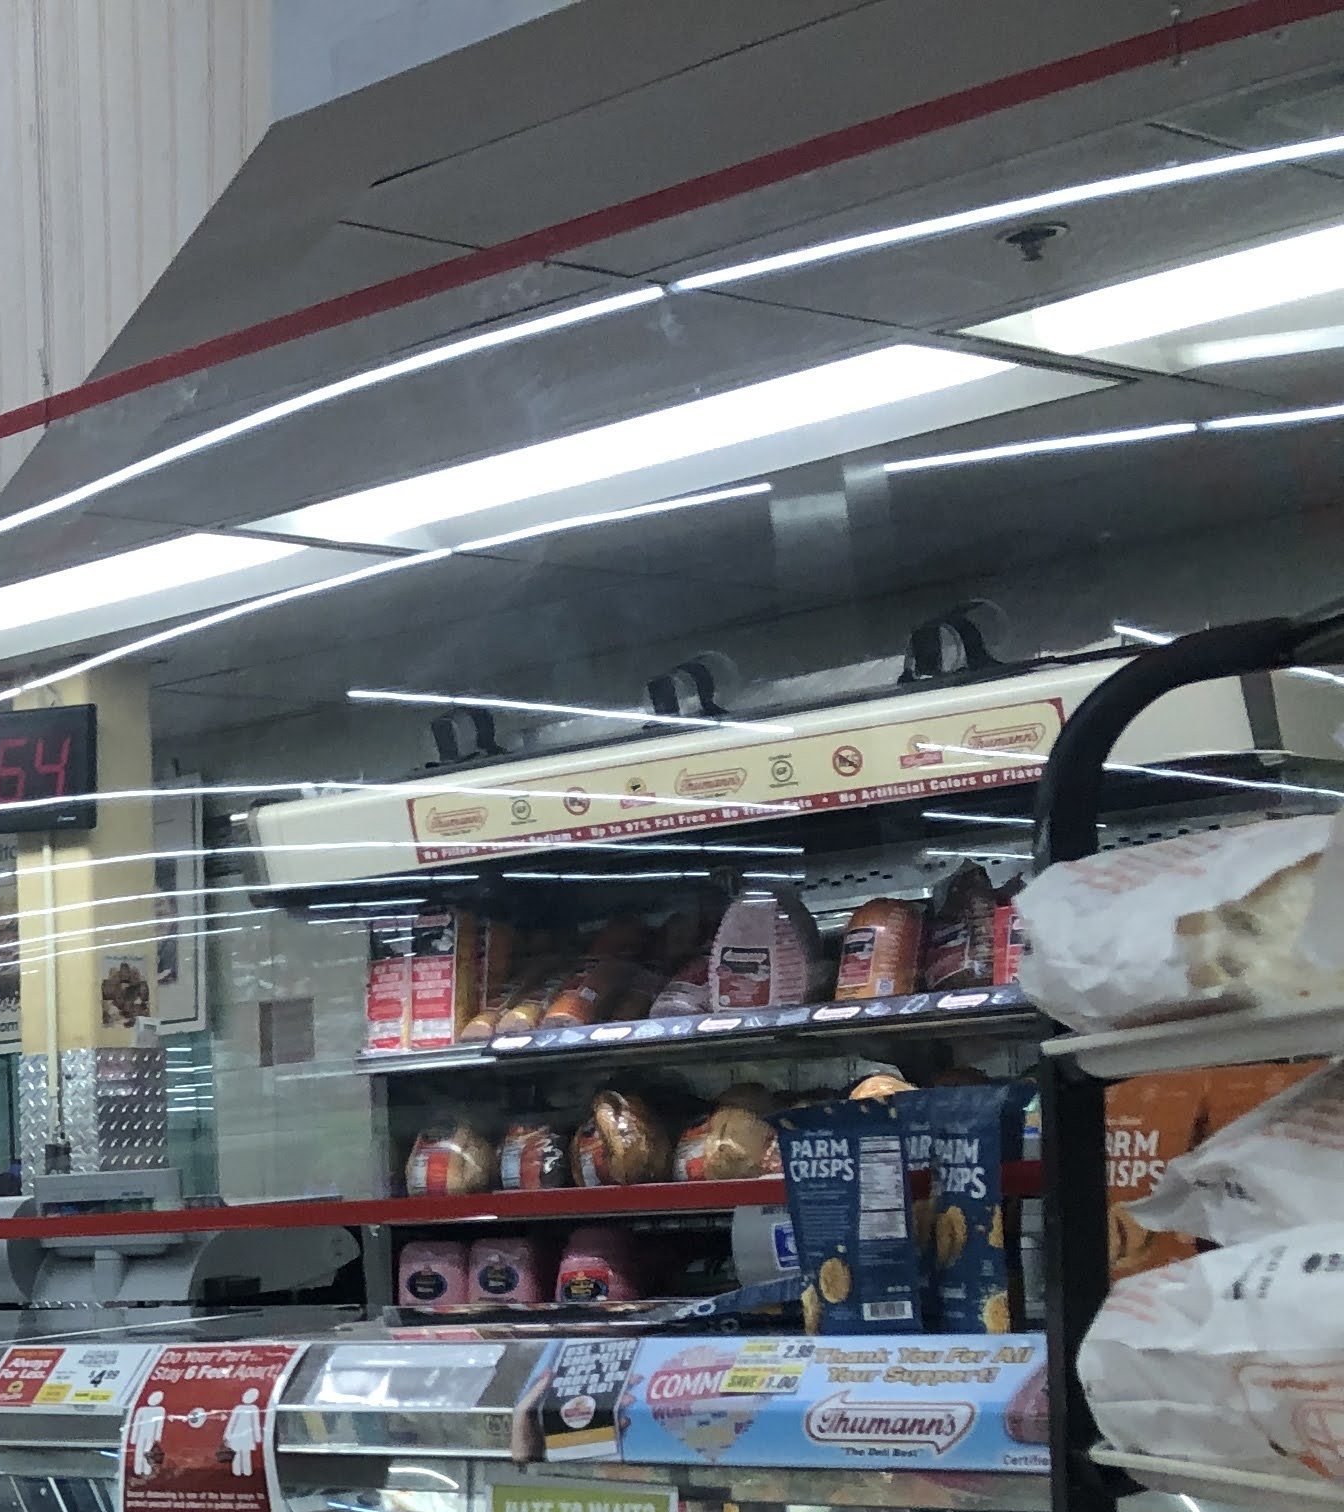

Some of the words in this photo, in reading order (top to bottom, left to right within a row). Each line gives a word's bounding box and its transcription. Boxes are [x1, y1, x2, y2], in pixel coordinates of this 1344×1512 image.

[626, 820, 652, 833] 97%
[655, 816, 676, 829] Fat
[678, 812, 706, 826] Free
[722, 807, 739, 819] No
[839, 789, 857, 802] No
[862, 783, 925, 801] Artificial
[930, 774, 977, 791] Colors
[983, 771, 999, 784] or
[790, 1138, 850, 1159] PARM
[789, 1158, 855, 1182] CRISPS
[1106, 1160, 1167, 1191] ISPS
[160, 1351, 182, 1363] Do
[184, 1351, 220, 1364] Your
[813, 1347, 892, 1364] Thank
[898, 1347, 944, 1364] You
[944, 1346, 991, 1363] For
[991, 1346, 1035, 1363] All
[150, 1365, 185, 1383] Stay
[650, 1369, 726, 1400] COMM
[828, 1366, 881, 1383] Your
[816, 1409, 957, 1437] Thumann's
